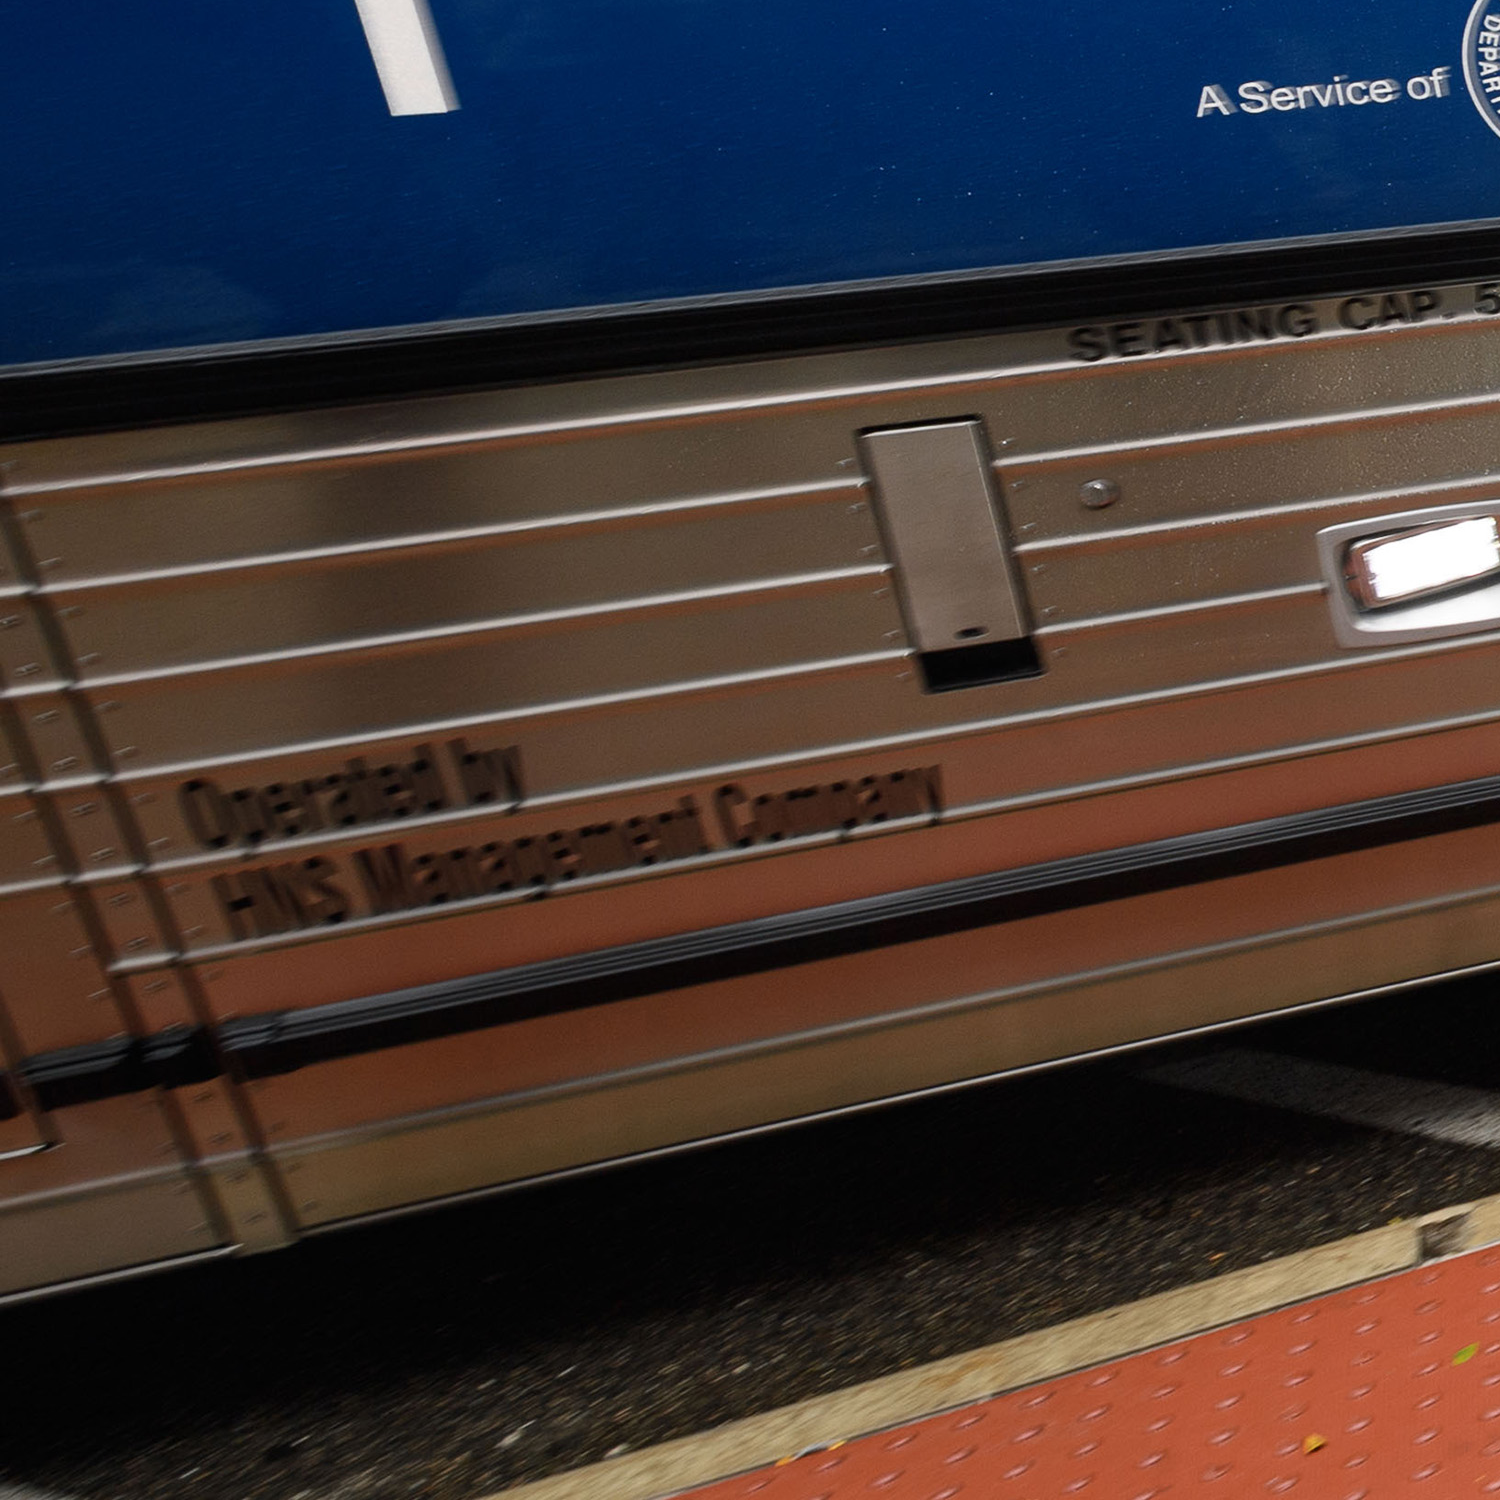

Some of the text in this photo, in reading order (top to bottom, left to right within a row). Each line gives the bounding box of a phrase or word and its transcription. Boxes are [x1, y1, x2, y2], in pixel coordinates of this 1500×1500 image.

[1196, 66, 1452, 118] A Service of
[1068, 300, 1318, 364] SEATING
[1335, 286, 1456, 333] CAP.
[179, 736, 524, 860] Operated by
[211, 762, 946, 942] HNS Management Company
